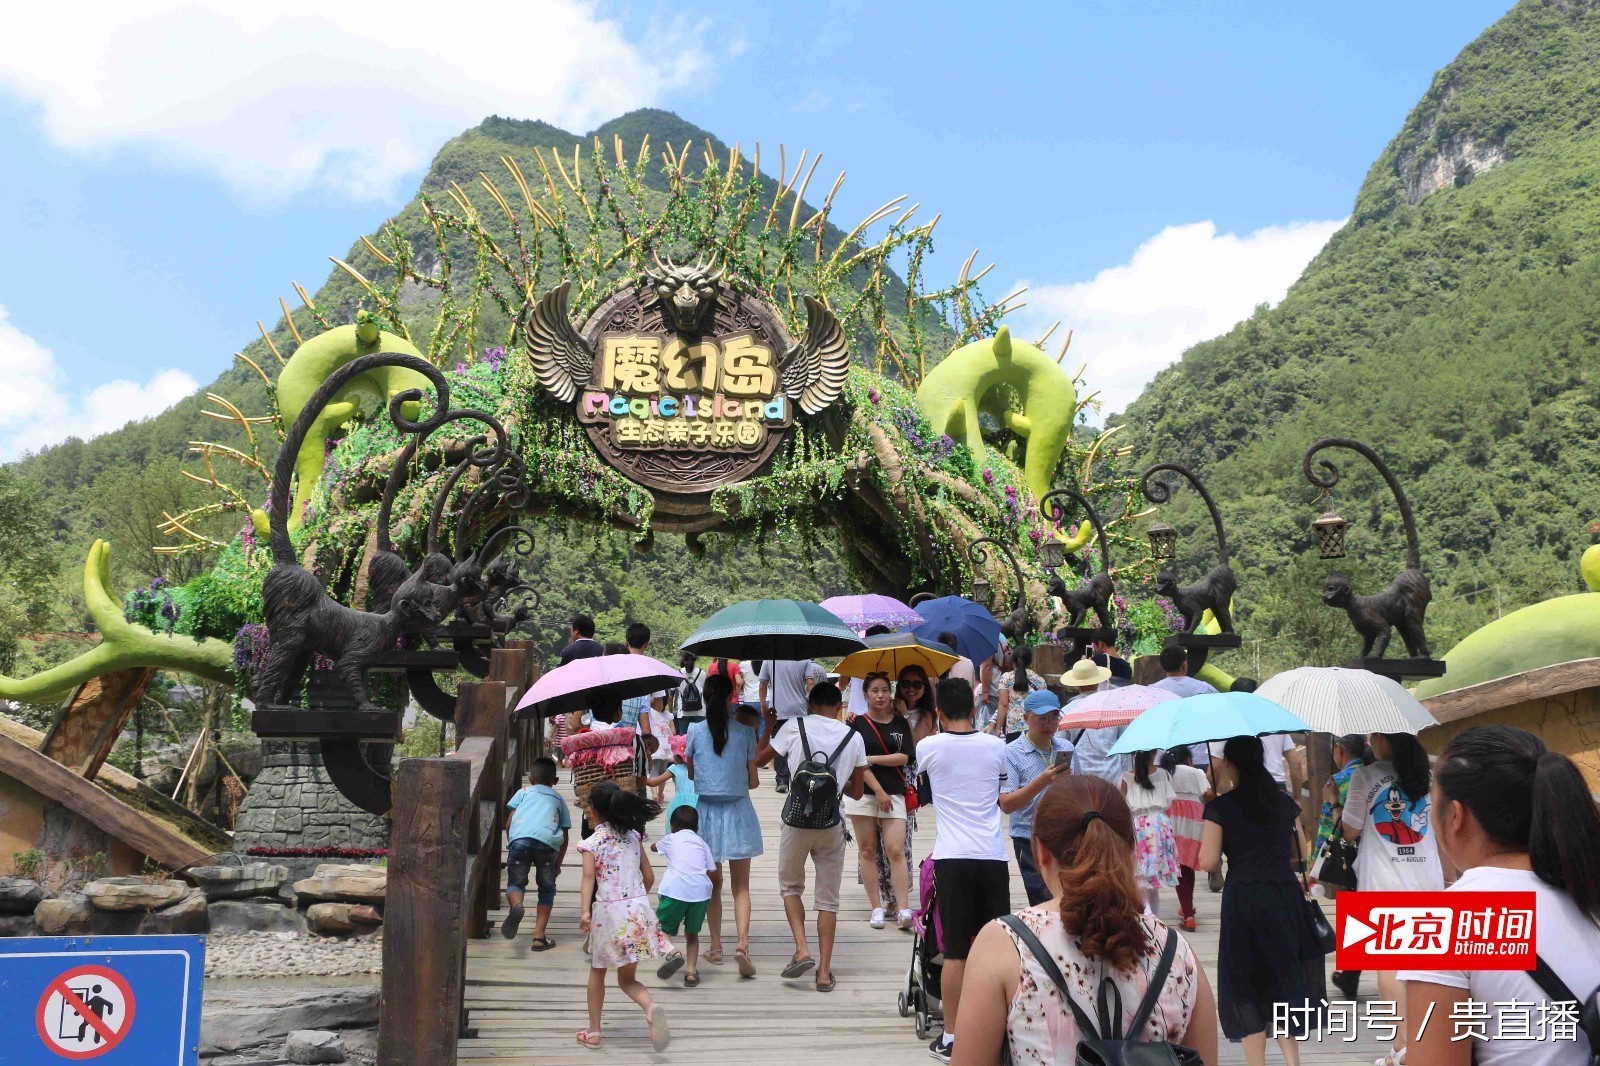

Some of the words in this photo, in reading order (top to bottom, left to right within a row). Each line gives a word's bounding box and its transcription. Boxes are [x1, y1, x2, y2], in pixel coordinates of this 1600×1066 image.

[603, 335, 775, 395] 魔幻岛
[585, 392, 677, 419] Magic
[684, 394, 784, 419] Island
[618, 420, 760, 446] 生态亲子乐园
